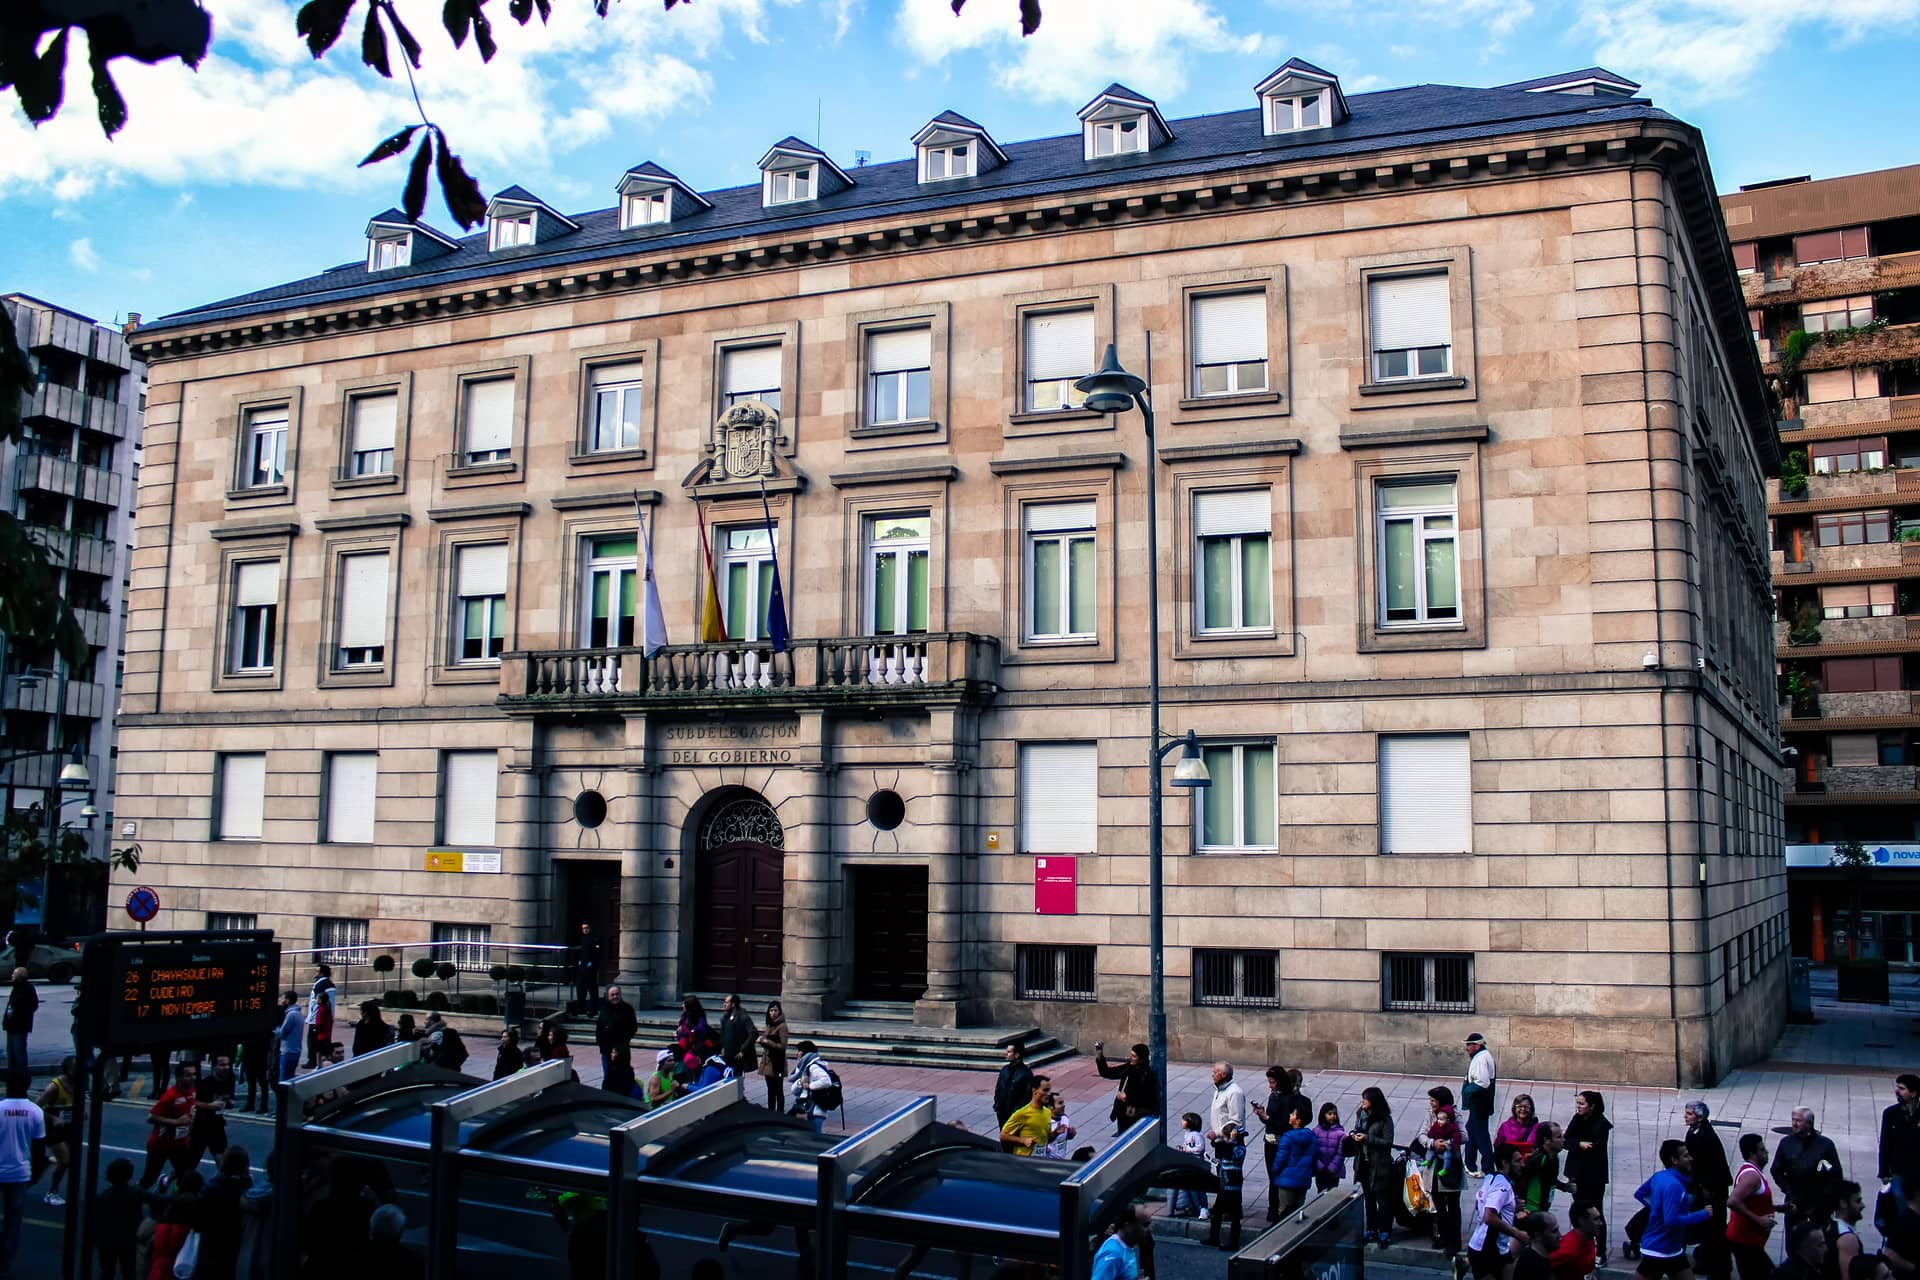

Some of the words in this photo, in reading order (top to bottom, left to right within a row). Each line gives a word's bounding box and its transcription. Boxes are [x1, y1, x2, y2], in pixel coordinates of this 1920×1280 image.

[666, 722, 798, 740] SUBDELEGACIÓN
[672, 751, 700, 764] DEL
[708, 750, 791, 763] GOBIERNO
[124, 971, 139, 984] 26
[151, 967, 224, 983] CHAVASQUEIRA
[250, 965, 268, 978] +15
[124, 988, 138, 1001] 22
[150, 986, 194, 999] CUDEIRO
[249, 981, 267, 994] +15
[137, 1005, 150, 1018] 17
[161, 1001, 216, 1016] NOVIEMBRE
[233, 998, 261, 1011] 11:35
